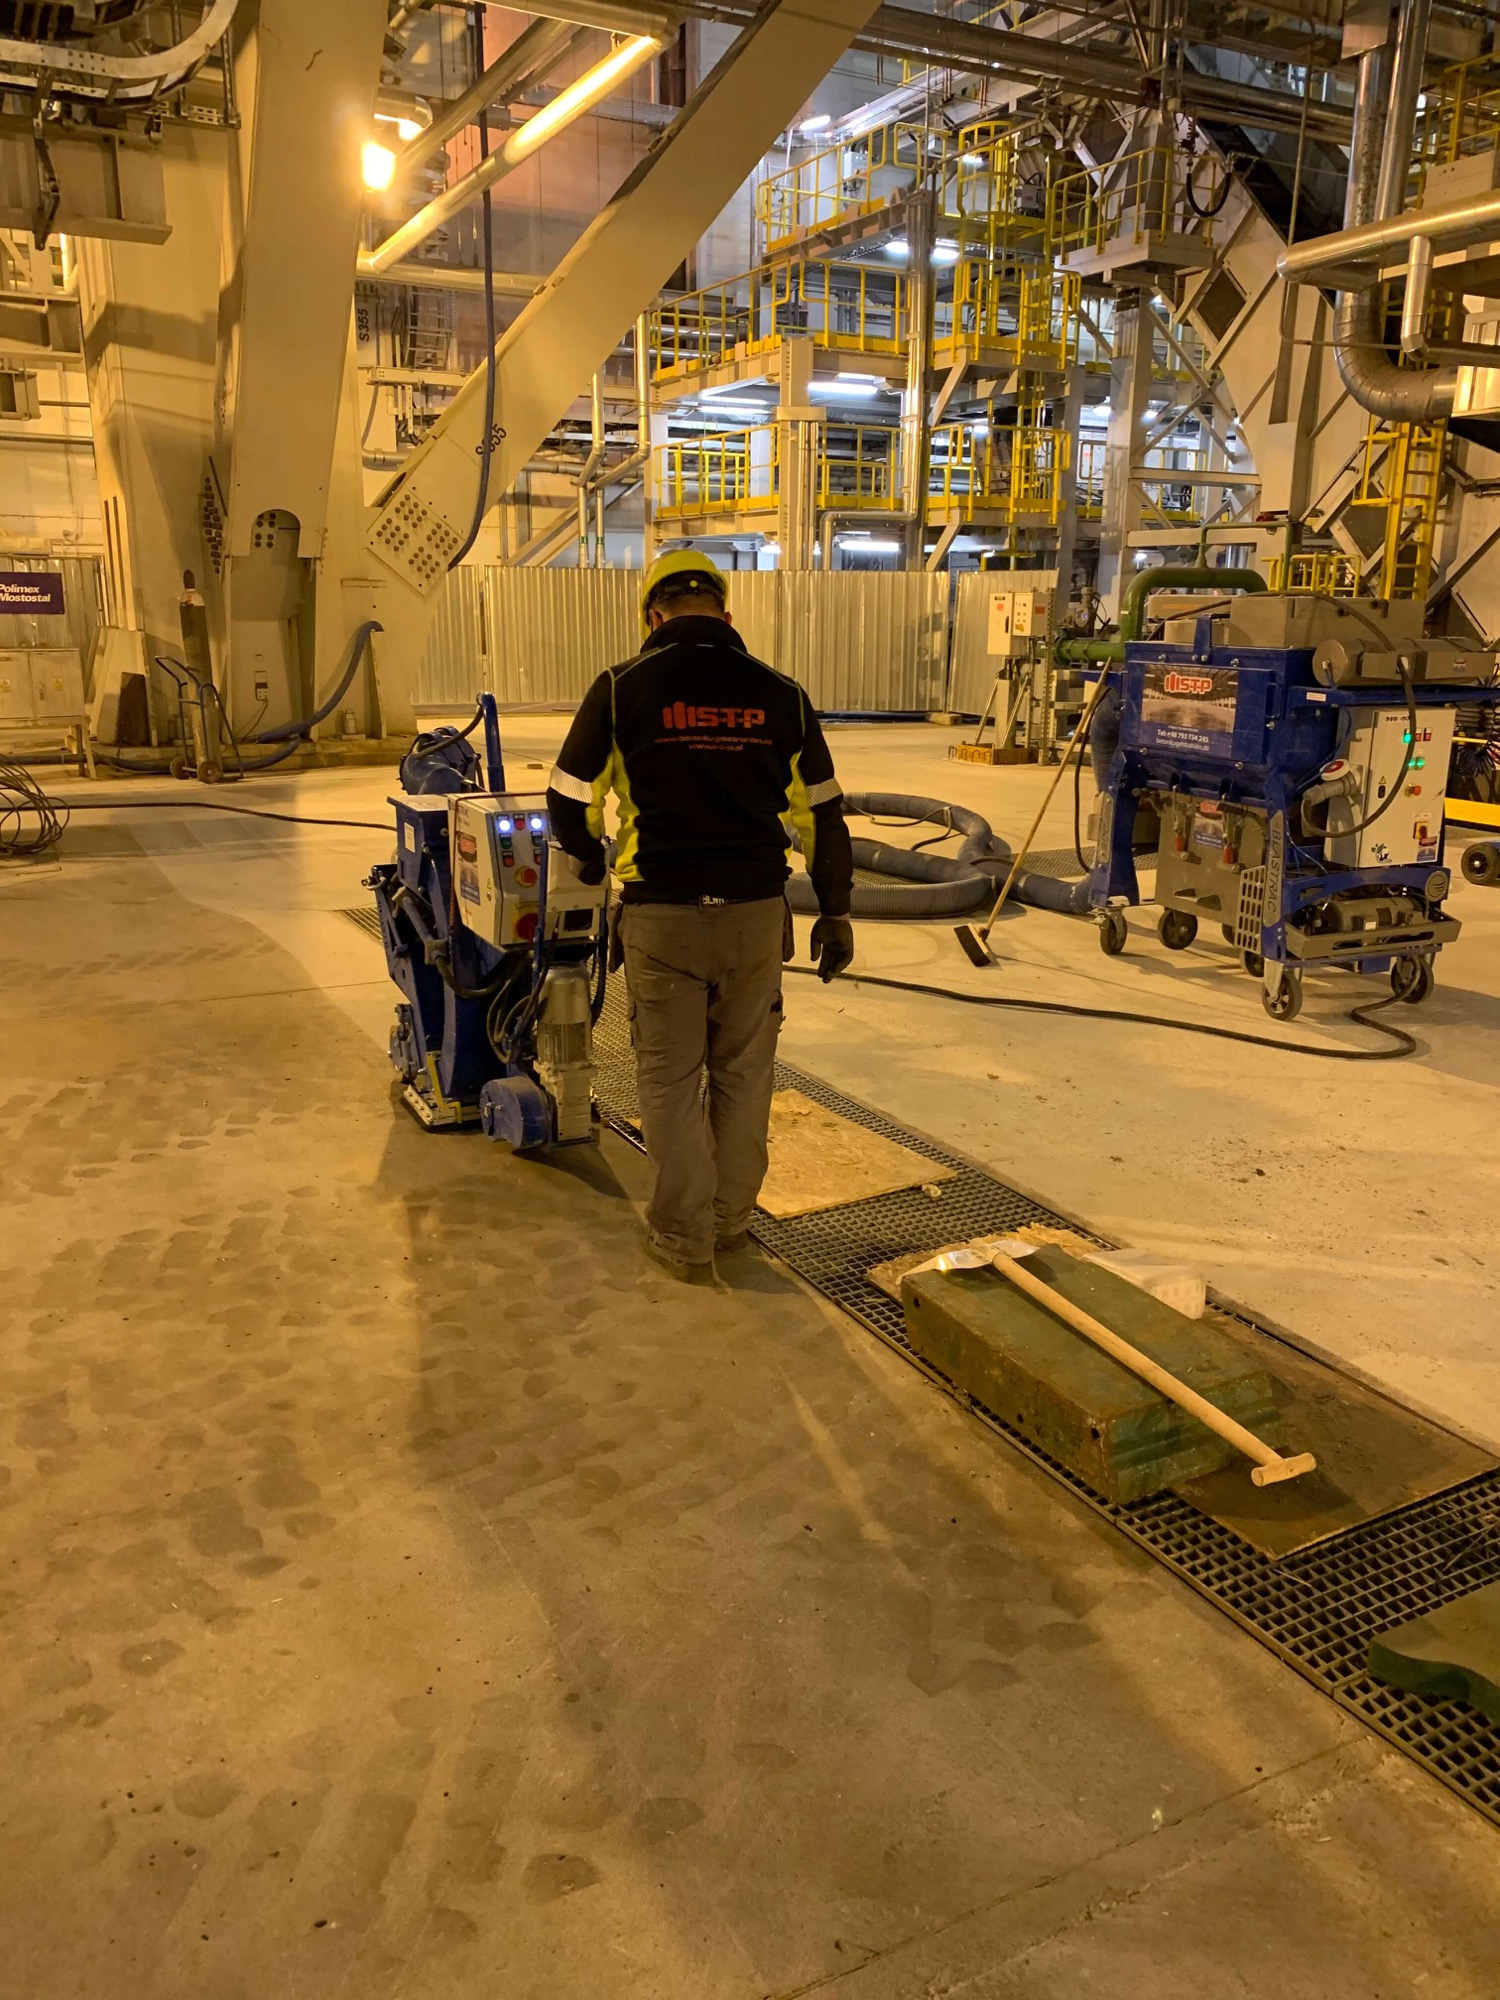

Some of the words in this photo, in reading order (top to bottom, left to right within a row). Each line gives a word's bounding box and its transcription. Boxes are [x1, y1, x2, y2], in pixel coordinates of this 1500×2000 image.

[357, 308, 370, 342] S355
[0, 584, 40, 593] Polimex
[0, 593, 51, 602] Mostostal
[1267, 829, 1281, 913] BLASTRAC
